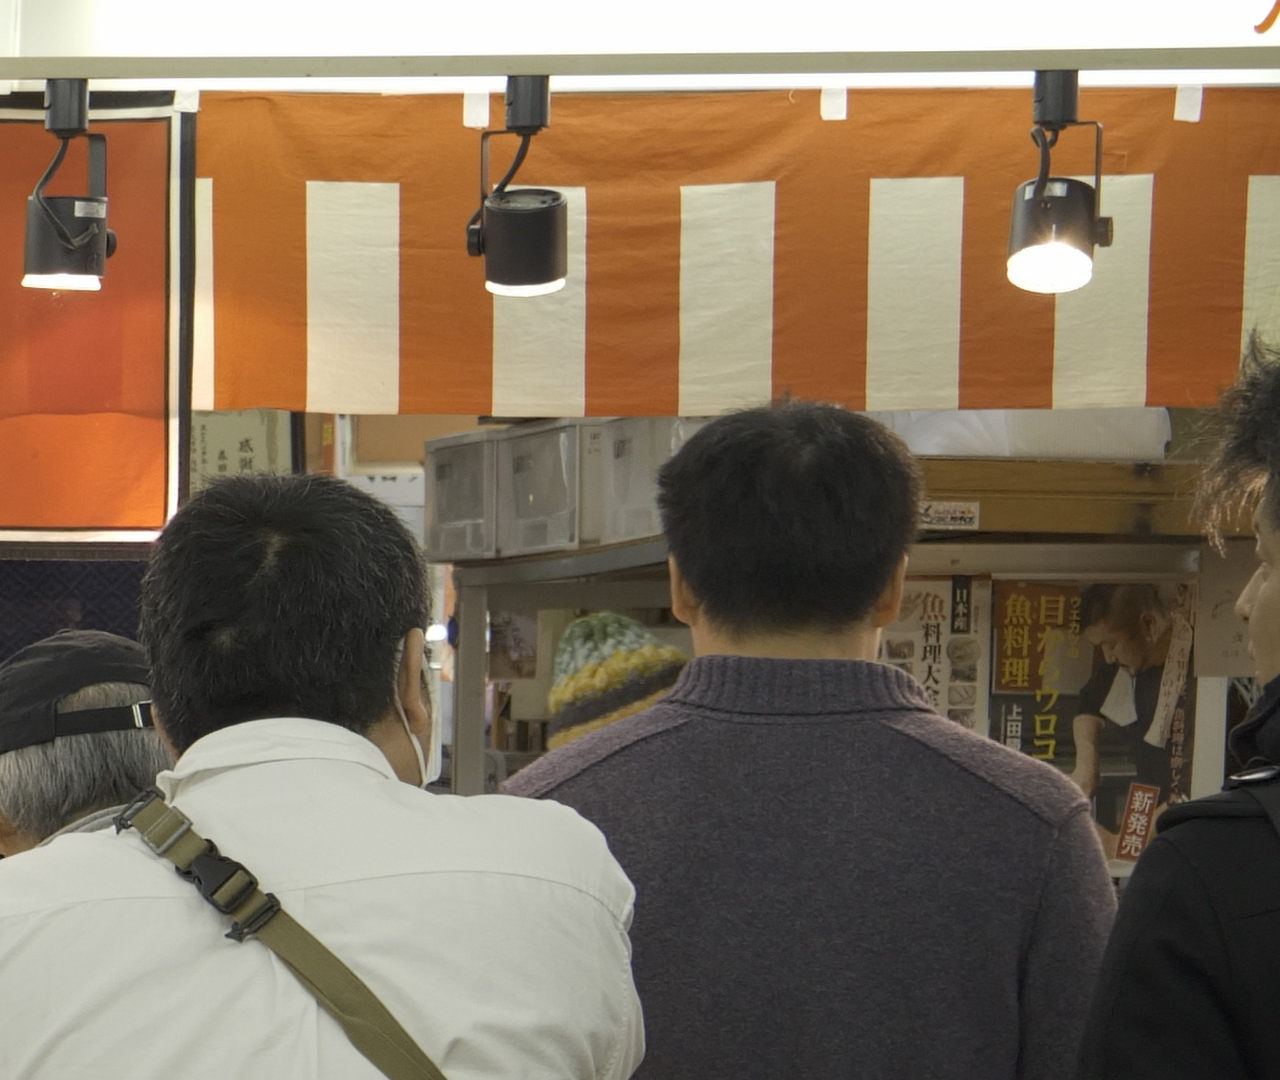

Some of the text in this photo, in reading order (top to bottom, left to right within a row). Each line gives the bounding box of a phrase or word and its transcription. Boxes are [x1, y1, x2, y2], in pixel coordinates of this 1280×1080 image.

[1001, 594, 1032, 688] 魚料理
[1121, 789, 1152, 857] 新発売
